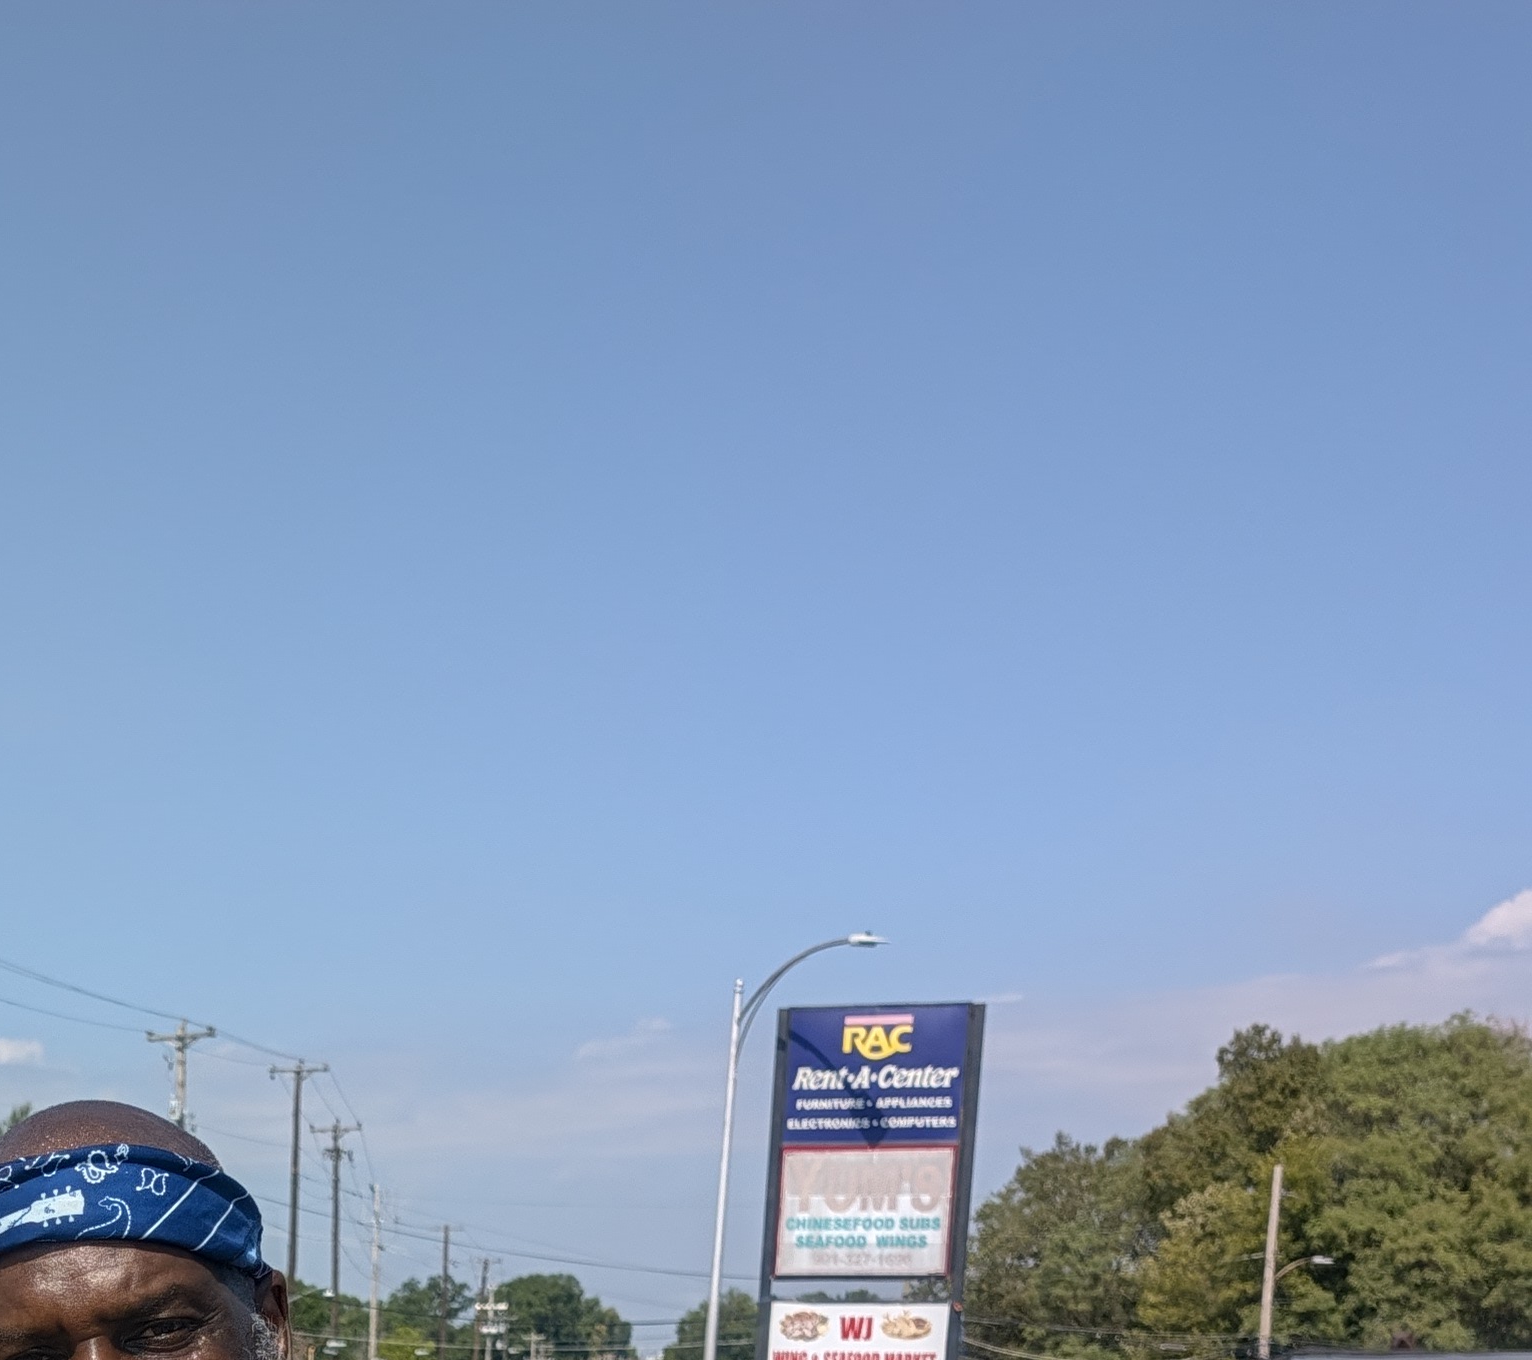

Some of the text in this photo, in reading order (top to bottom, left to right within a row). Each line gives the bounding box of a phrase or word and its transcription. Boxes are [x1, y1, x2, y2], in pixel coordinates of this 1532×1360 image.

[842, 1024, 914, 1061] RAC
[796, 1096, 953, 1111] FURNITURE APPLIANCES
[786, 1115, 957, 1130] ELECTRONICS COMPUTERS
[899, 1216, 941, 1231] SUBS
[795, 1234, 928, 1249] SEAFOOD WINGS
[839, 1315, 874, 1341] WJ
